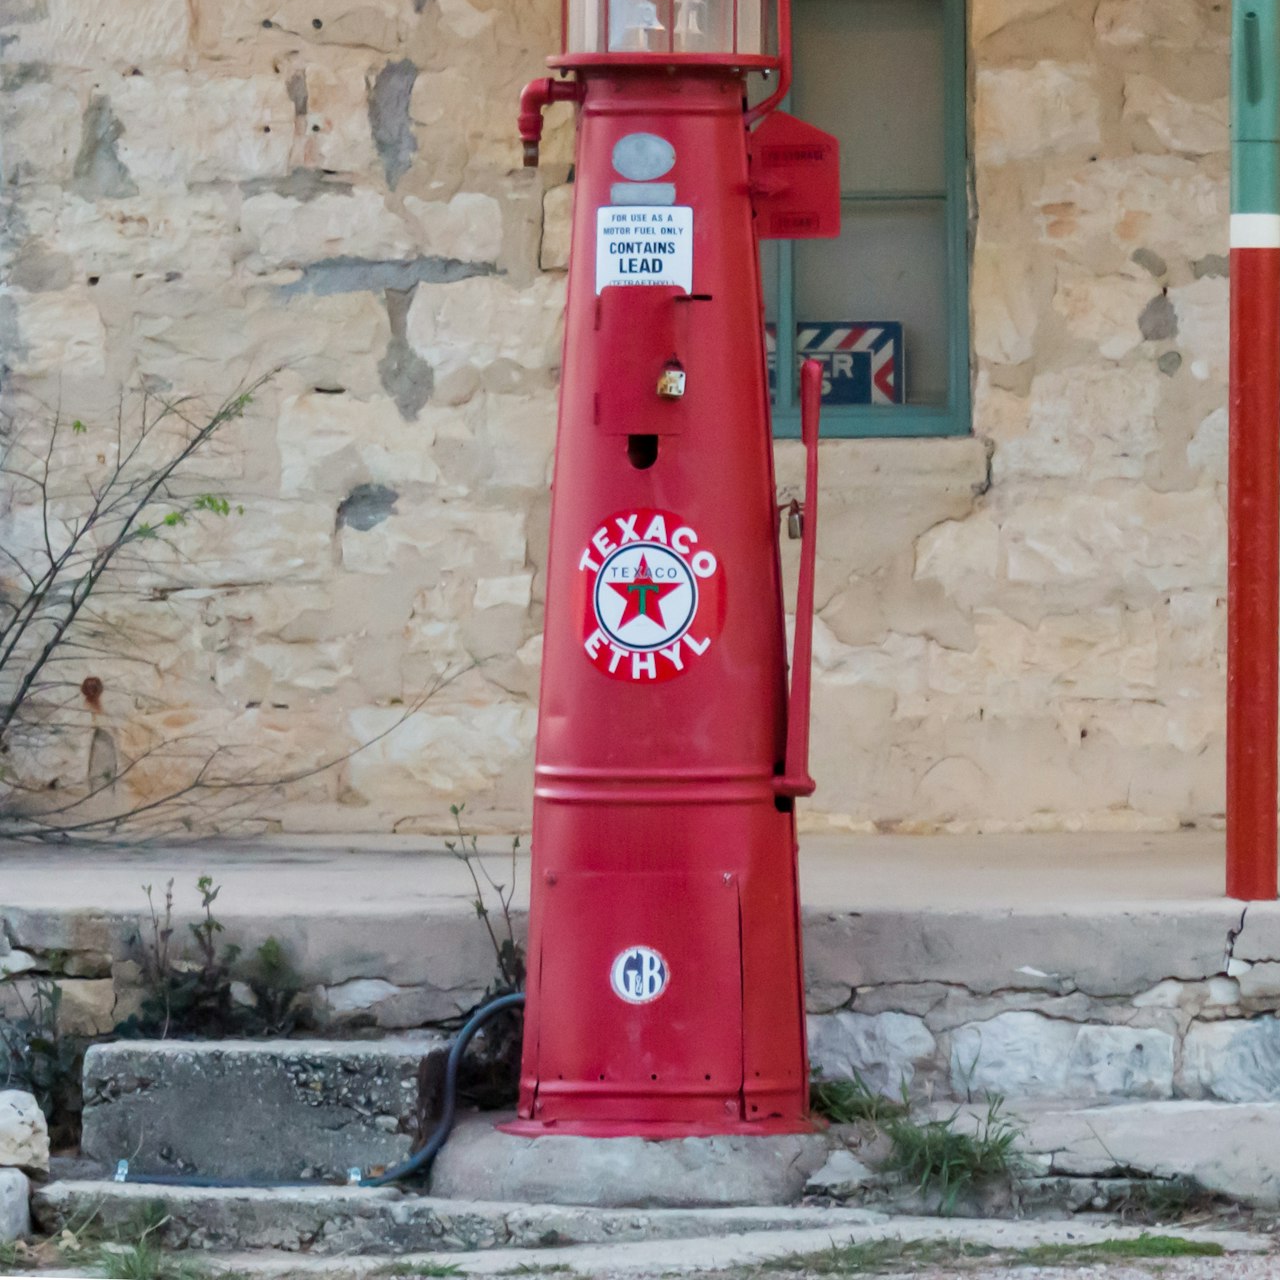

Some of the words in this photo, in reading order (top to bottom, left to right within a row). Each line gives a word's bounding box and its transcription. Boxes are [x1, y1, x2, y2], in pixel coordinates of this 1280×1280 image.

[612, 214, 627, 222] FOR
[630, 214, 647, 222] USE
[651, 214, 663, 222] AS
[667, 214, 673, 222] A
[603, 227, 631, 235] MOTOR
[634, 227, 656, 235] FUEL
[660, 227, 684, 235] ONLY
[609, 241, 675, 254] CONTAINS
[619, 258, 663, 273] LEAD
[578, 513, 717, 579] TEXACO
[611, 567, 678, 579] TEXACO
[583, 628, 711, 680] ETHYL
